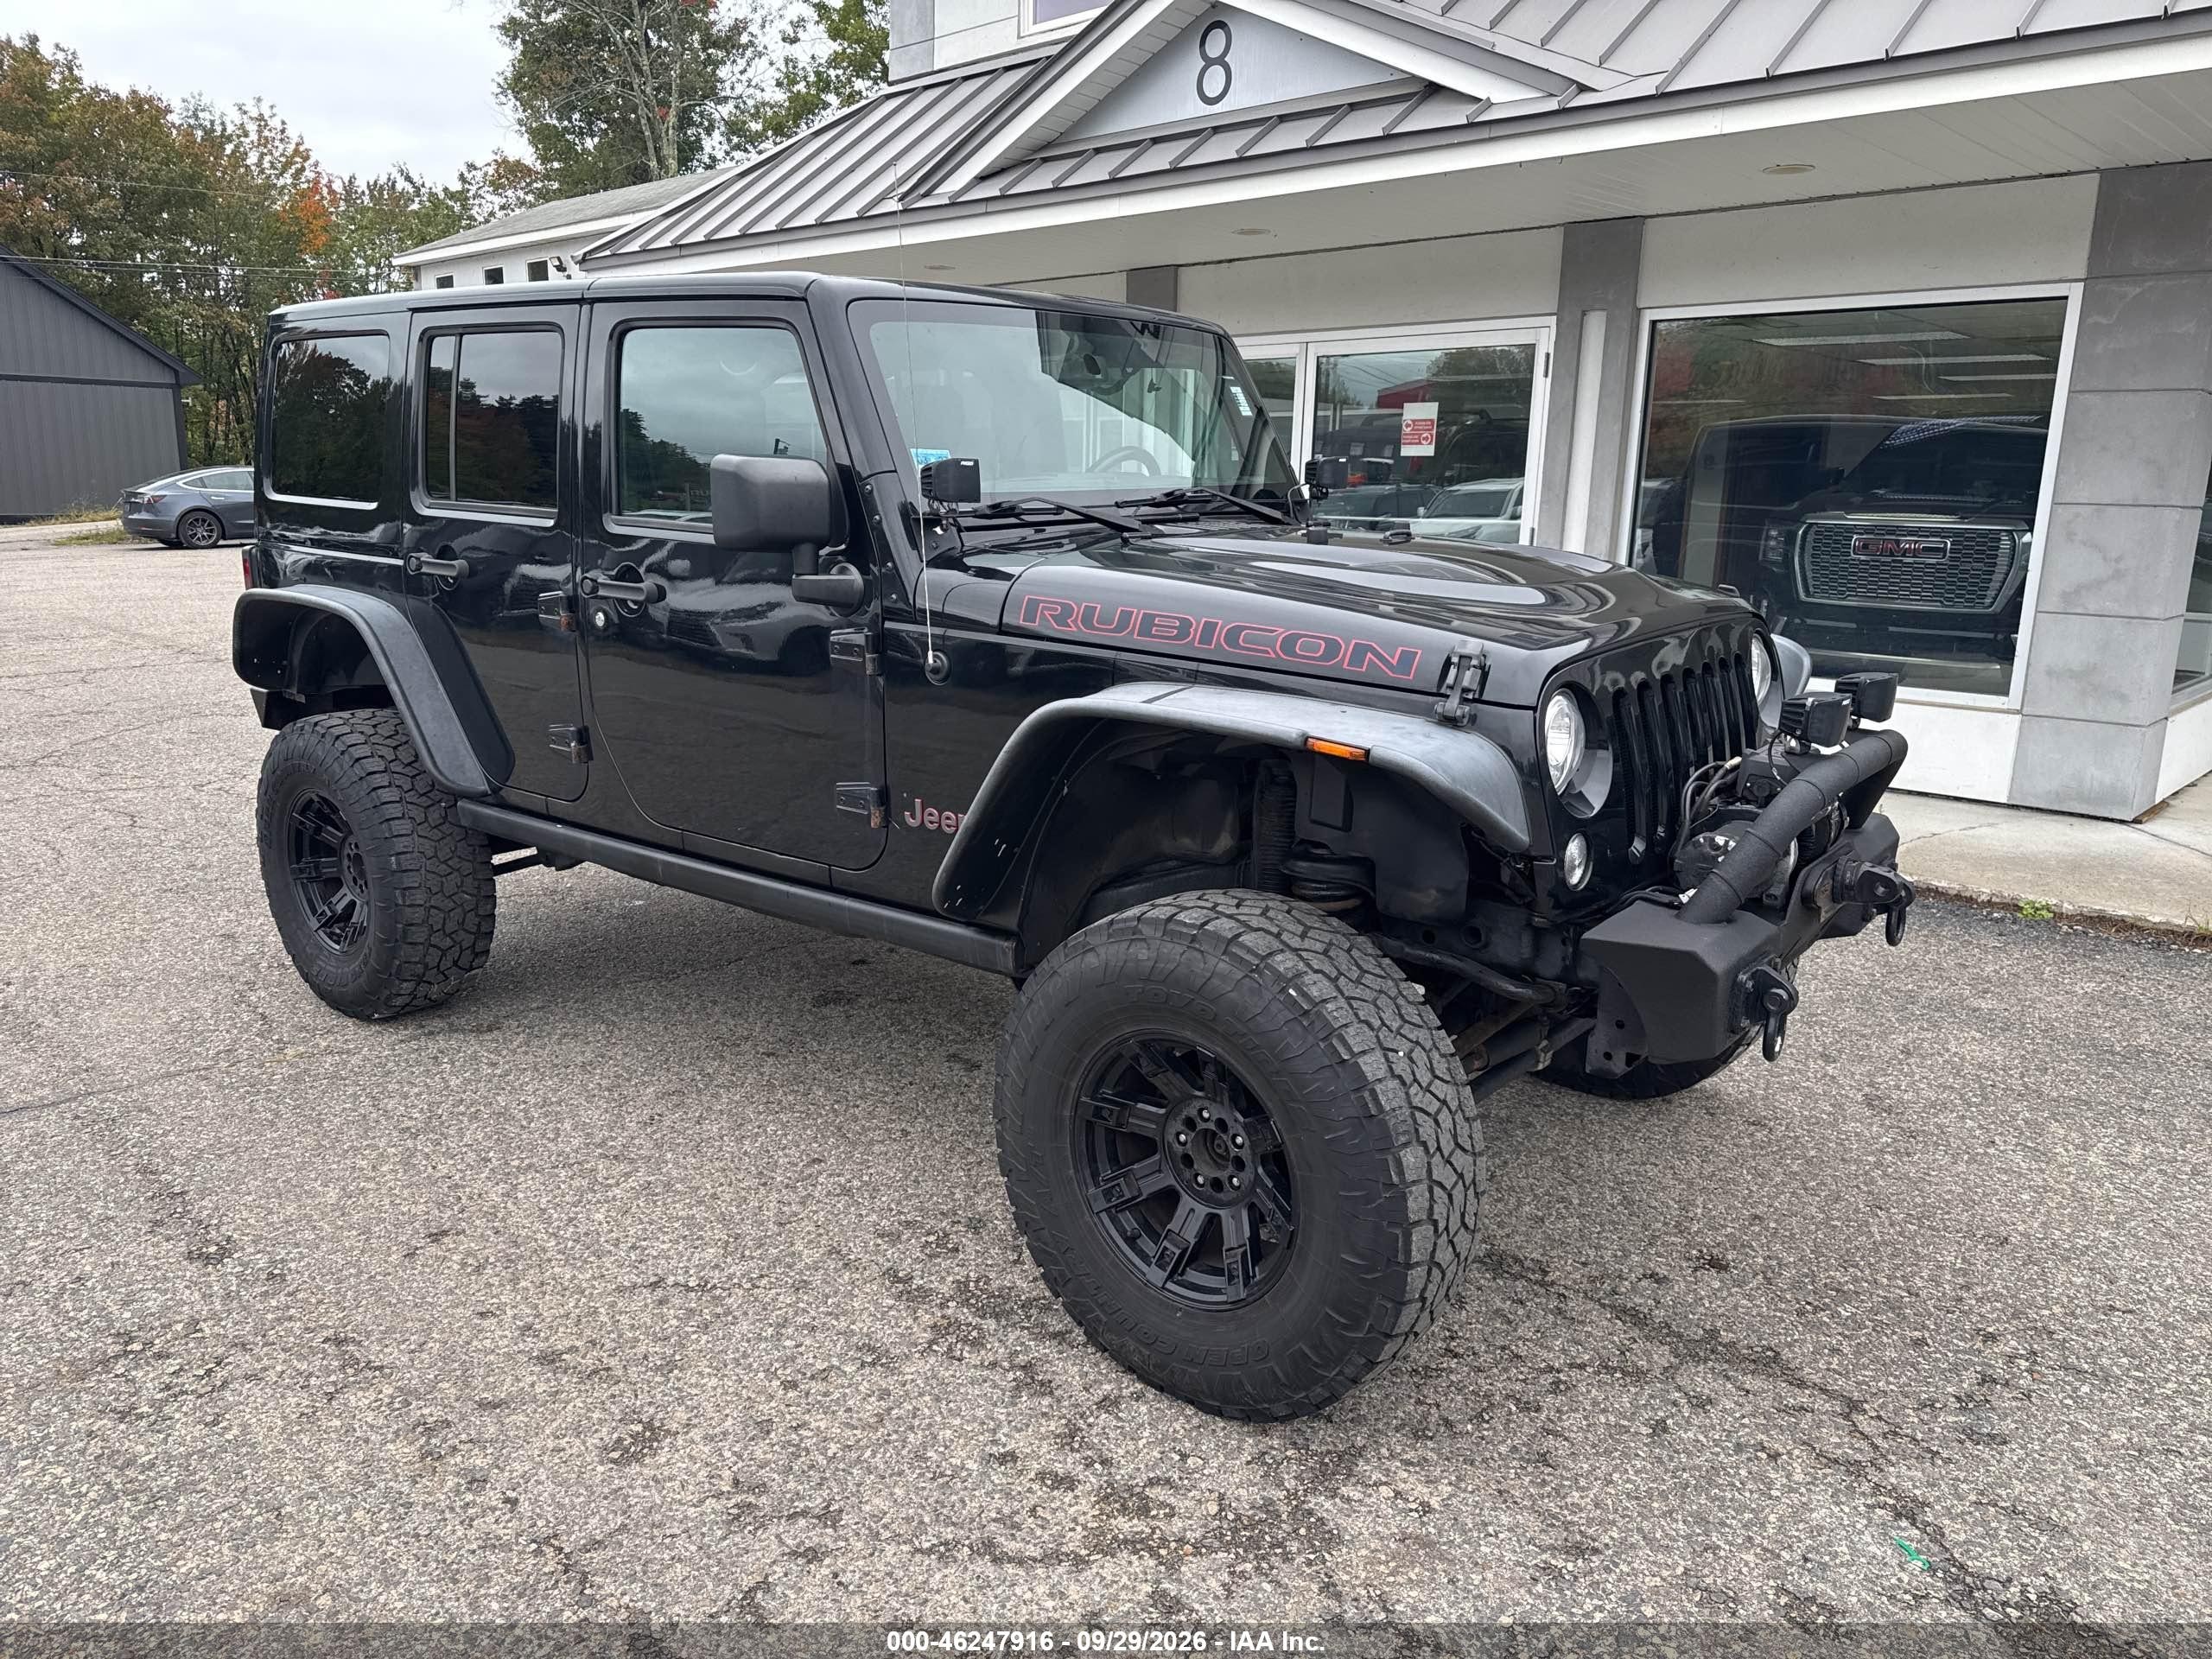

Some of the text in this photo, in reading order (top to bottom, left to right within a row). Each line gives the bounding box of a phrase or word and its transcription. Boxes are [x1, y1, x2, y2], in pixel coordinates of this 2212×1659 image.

[1197, 20, 1232, 106] 8
[1856, 538, 1944, 557] GMC
[1019, 594, 1422, 680] RUBICON
[1122, 984, 1217, 1020] TOYO
[1183, 1338, 1270, 1367] OPEN
